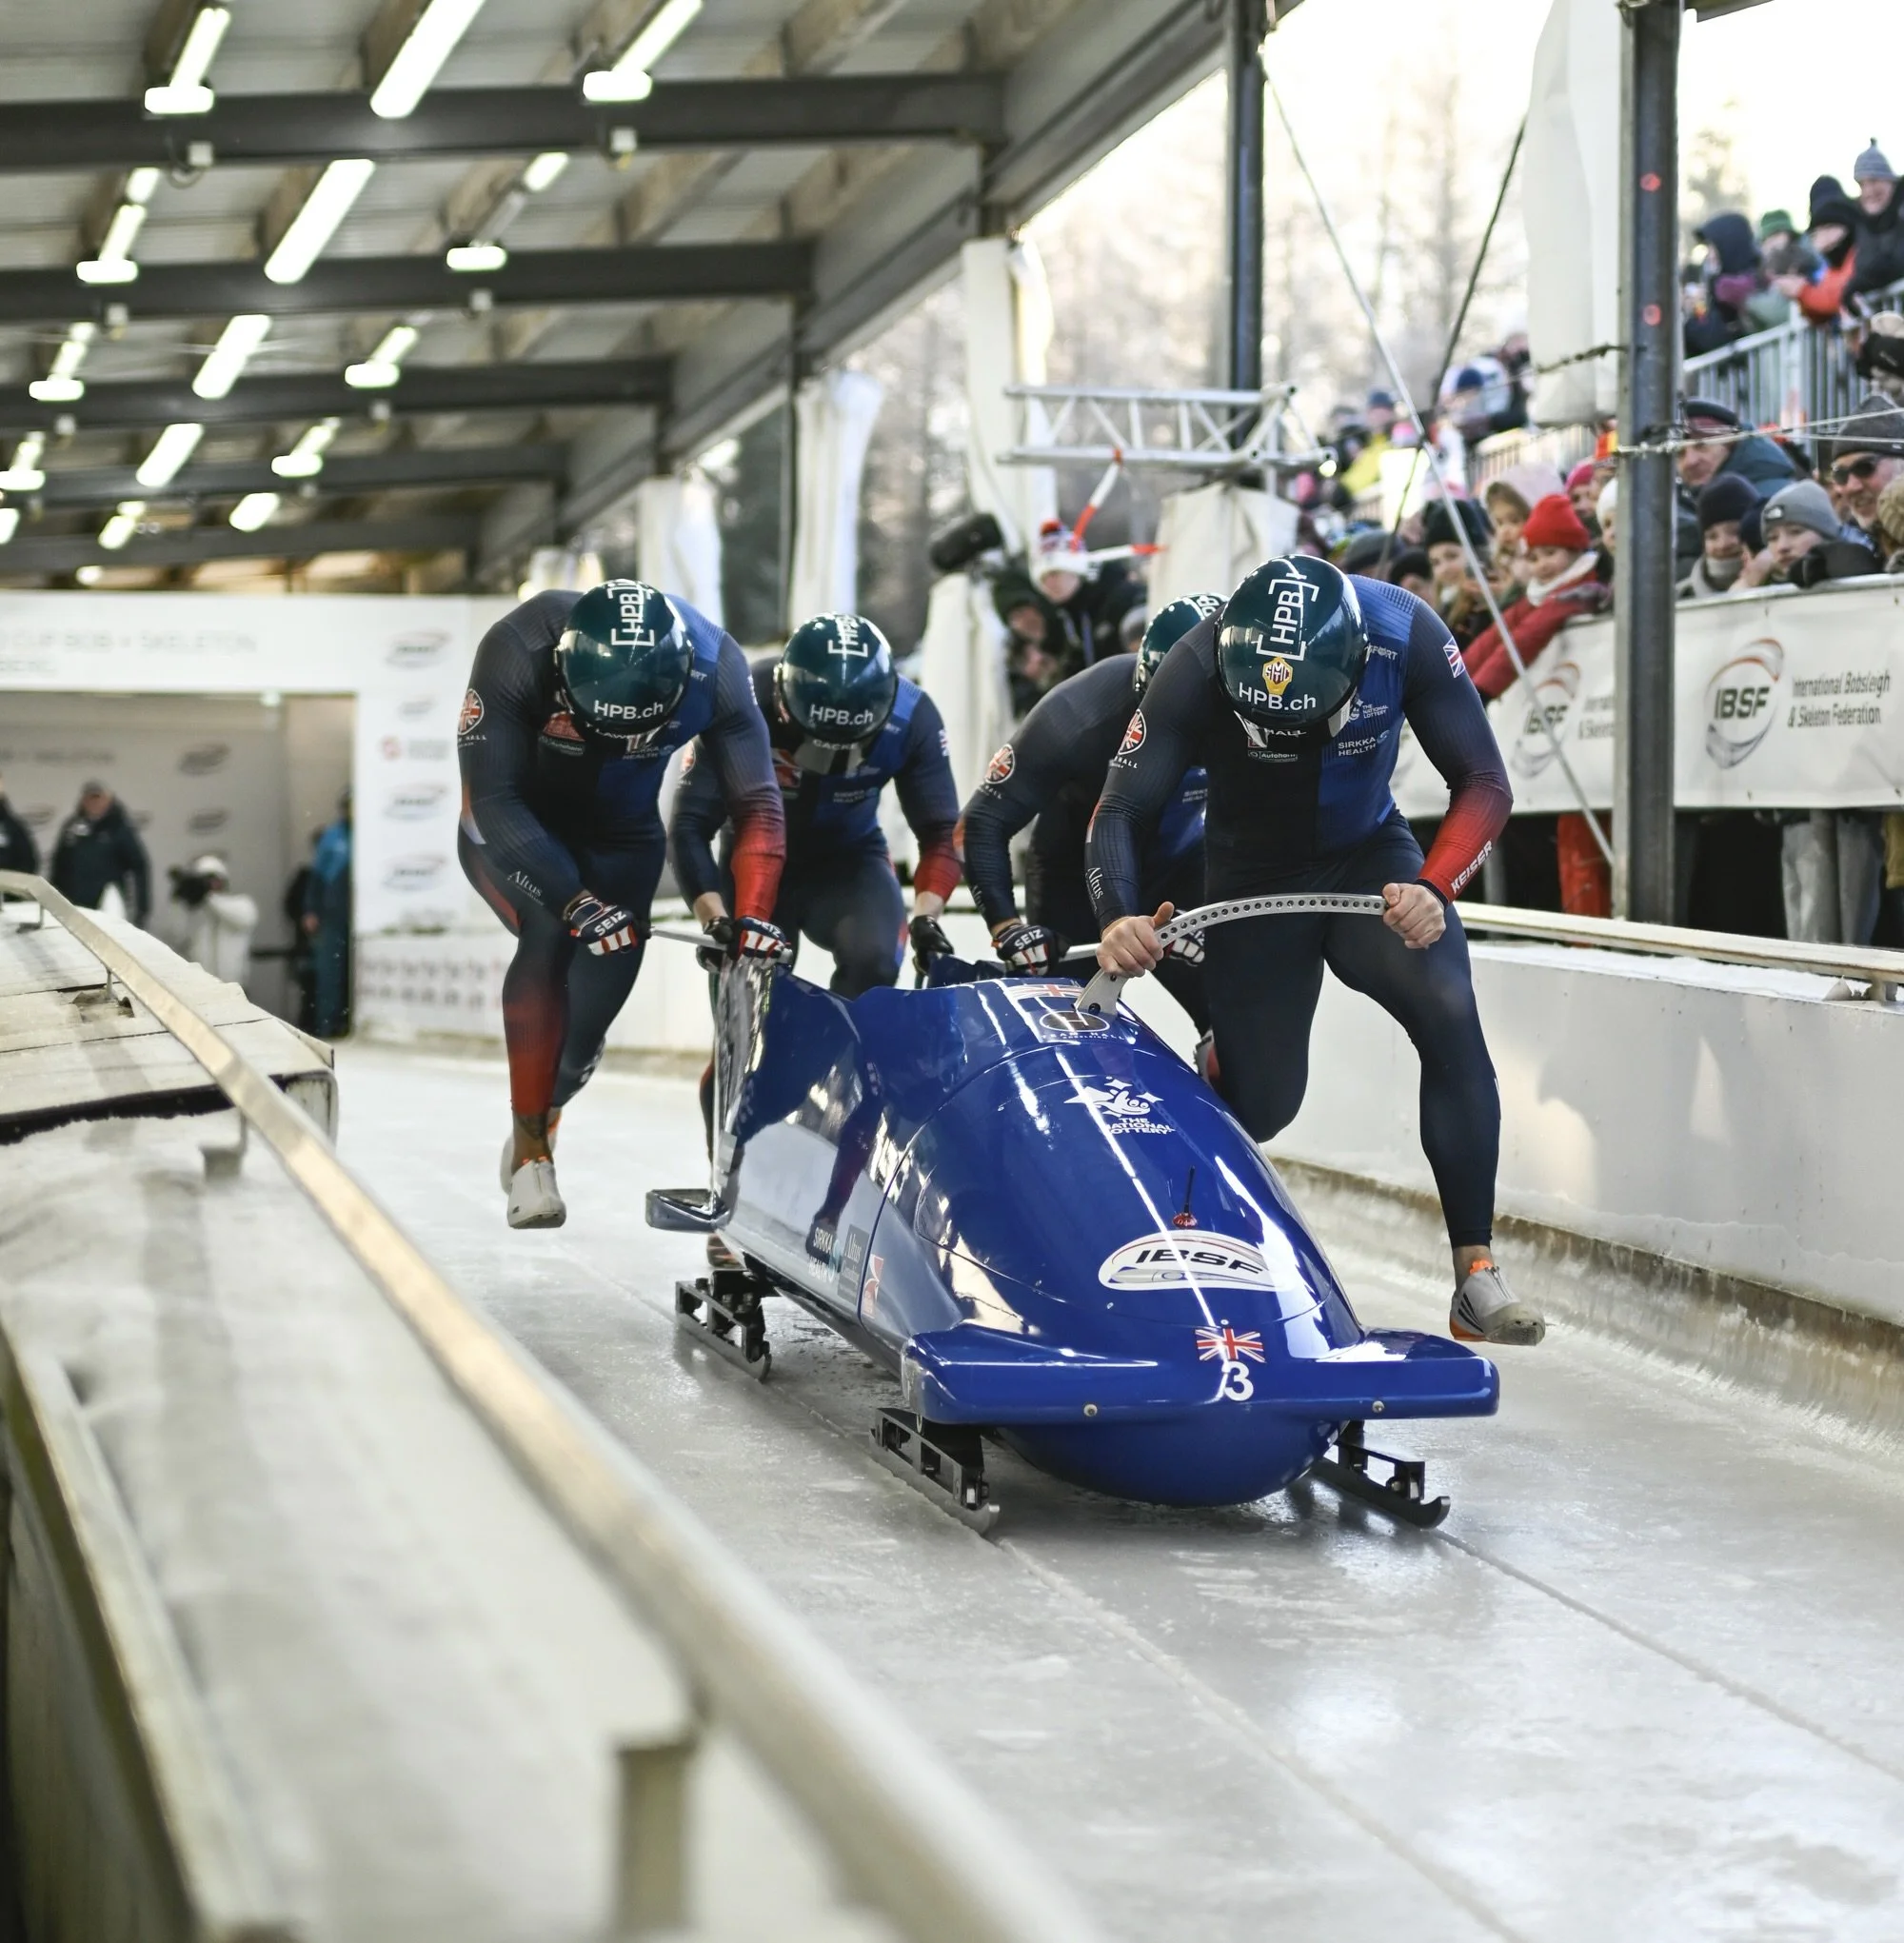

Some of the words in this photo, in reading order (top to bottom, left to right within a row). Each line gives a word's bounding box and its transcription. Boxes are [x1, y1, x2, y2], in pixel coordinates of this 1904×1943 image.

[1239, 682, 1317, 710] HPB.ch
[1792, 672, 1843, 698] International
[1844, 668, 1891, 698] Bobsleigh
[594, 700, 664, 720] HPB.ch
[810, 704, 873, 725] HPB.ch
[1715, 685, 1770, 721] IBSF
[1787, 707, 1795, 728] &
[1797, 707, 1831, 728] Skeleton
[1833, 703, 1882, 728] Federation
[1338, 737, 1377, 749] SIRKKA
[1339, 743, 1377, 757] HEALTH
[1450, 840, 1493, 895] KEISER
[506, 870, 543, 898] Altus
[1086, 867, 1104, 900] Altus
[594, 910, 627, 937] SEIZ
[1014, 928, 1043, 950] SEIZ
[1135, 1248, 1263, 1275] IBSF
[1224, 1360, 1255, 1401] 3
